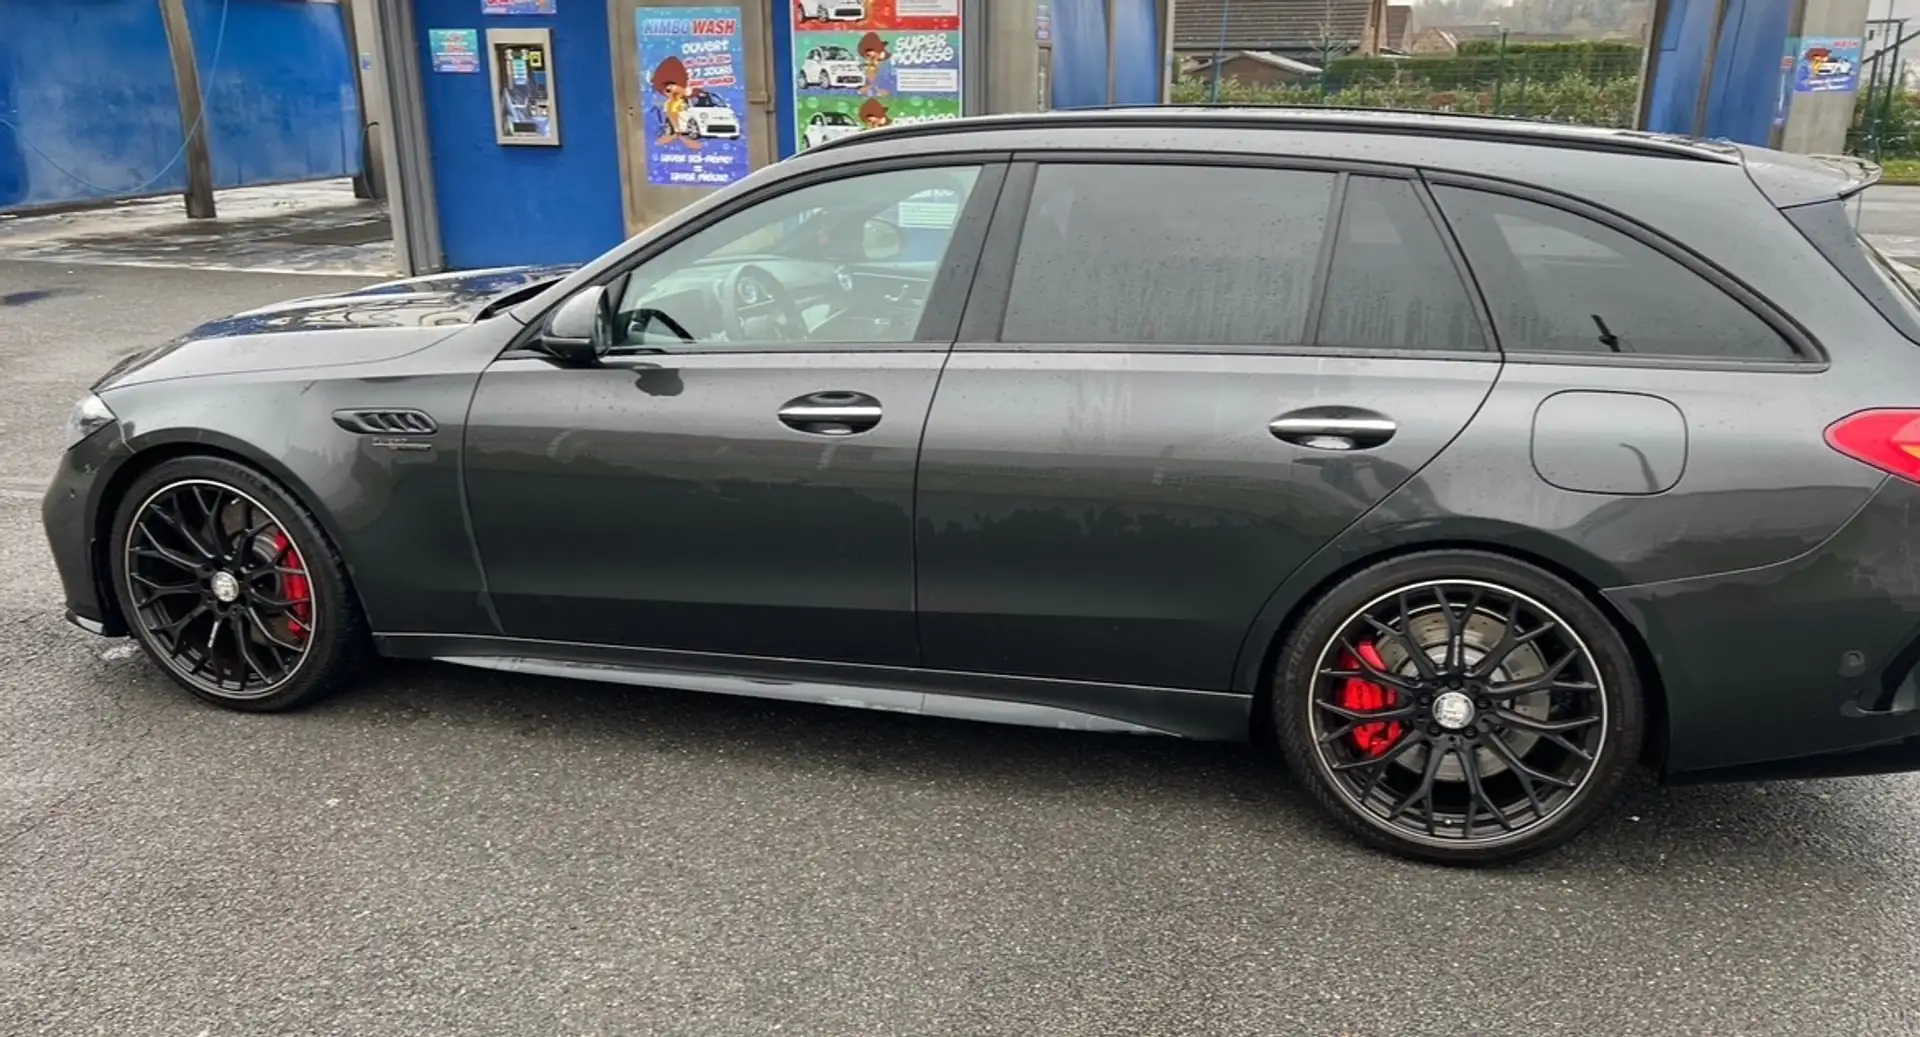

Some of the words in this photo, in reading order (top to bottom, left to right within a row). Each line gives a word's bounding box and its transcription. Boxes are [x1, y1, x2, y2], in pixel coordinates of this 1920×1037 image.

[691, 18, 737, 35] WASH
[682, 40, 730, 54] OUVERT
[895, 33, 947, 52] SUPER
[890, 46, 954, 66] MOUSSE
